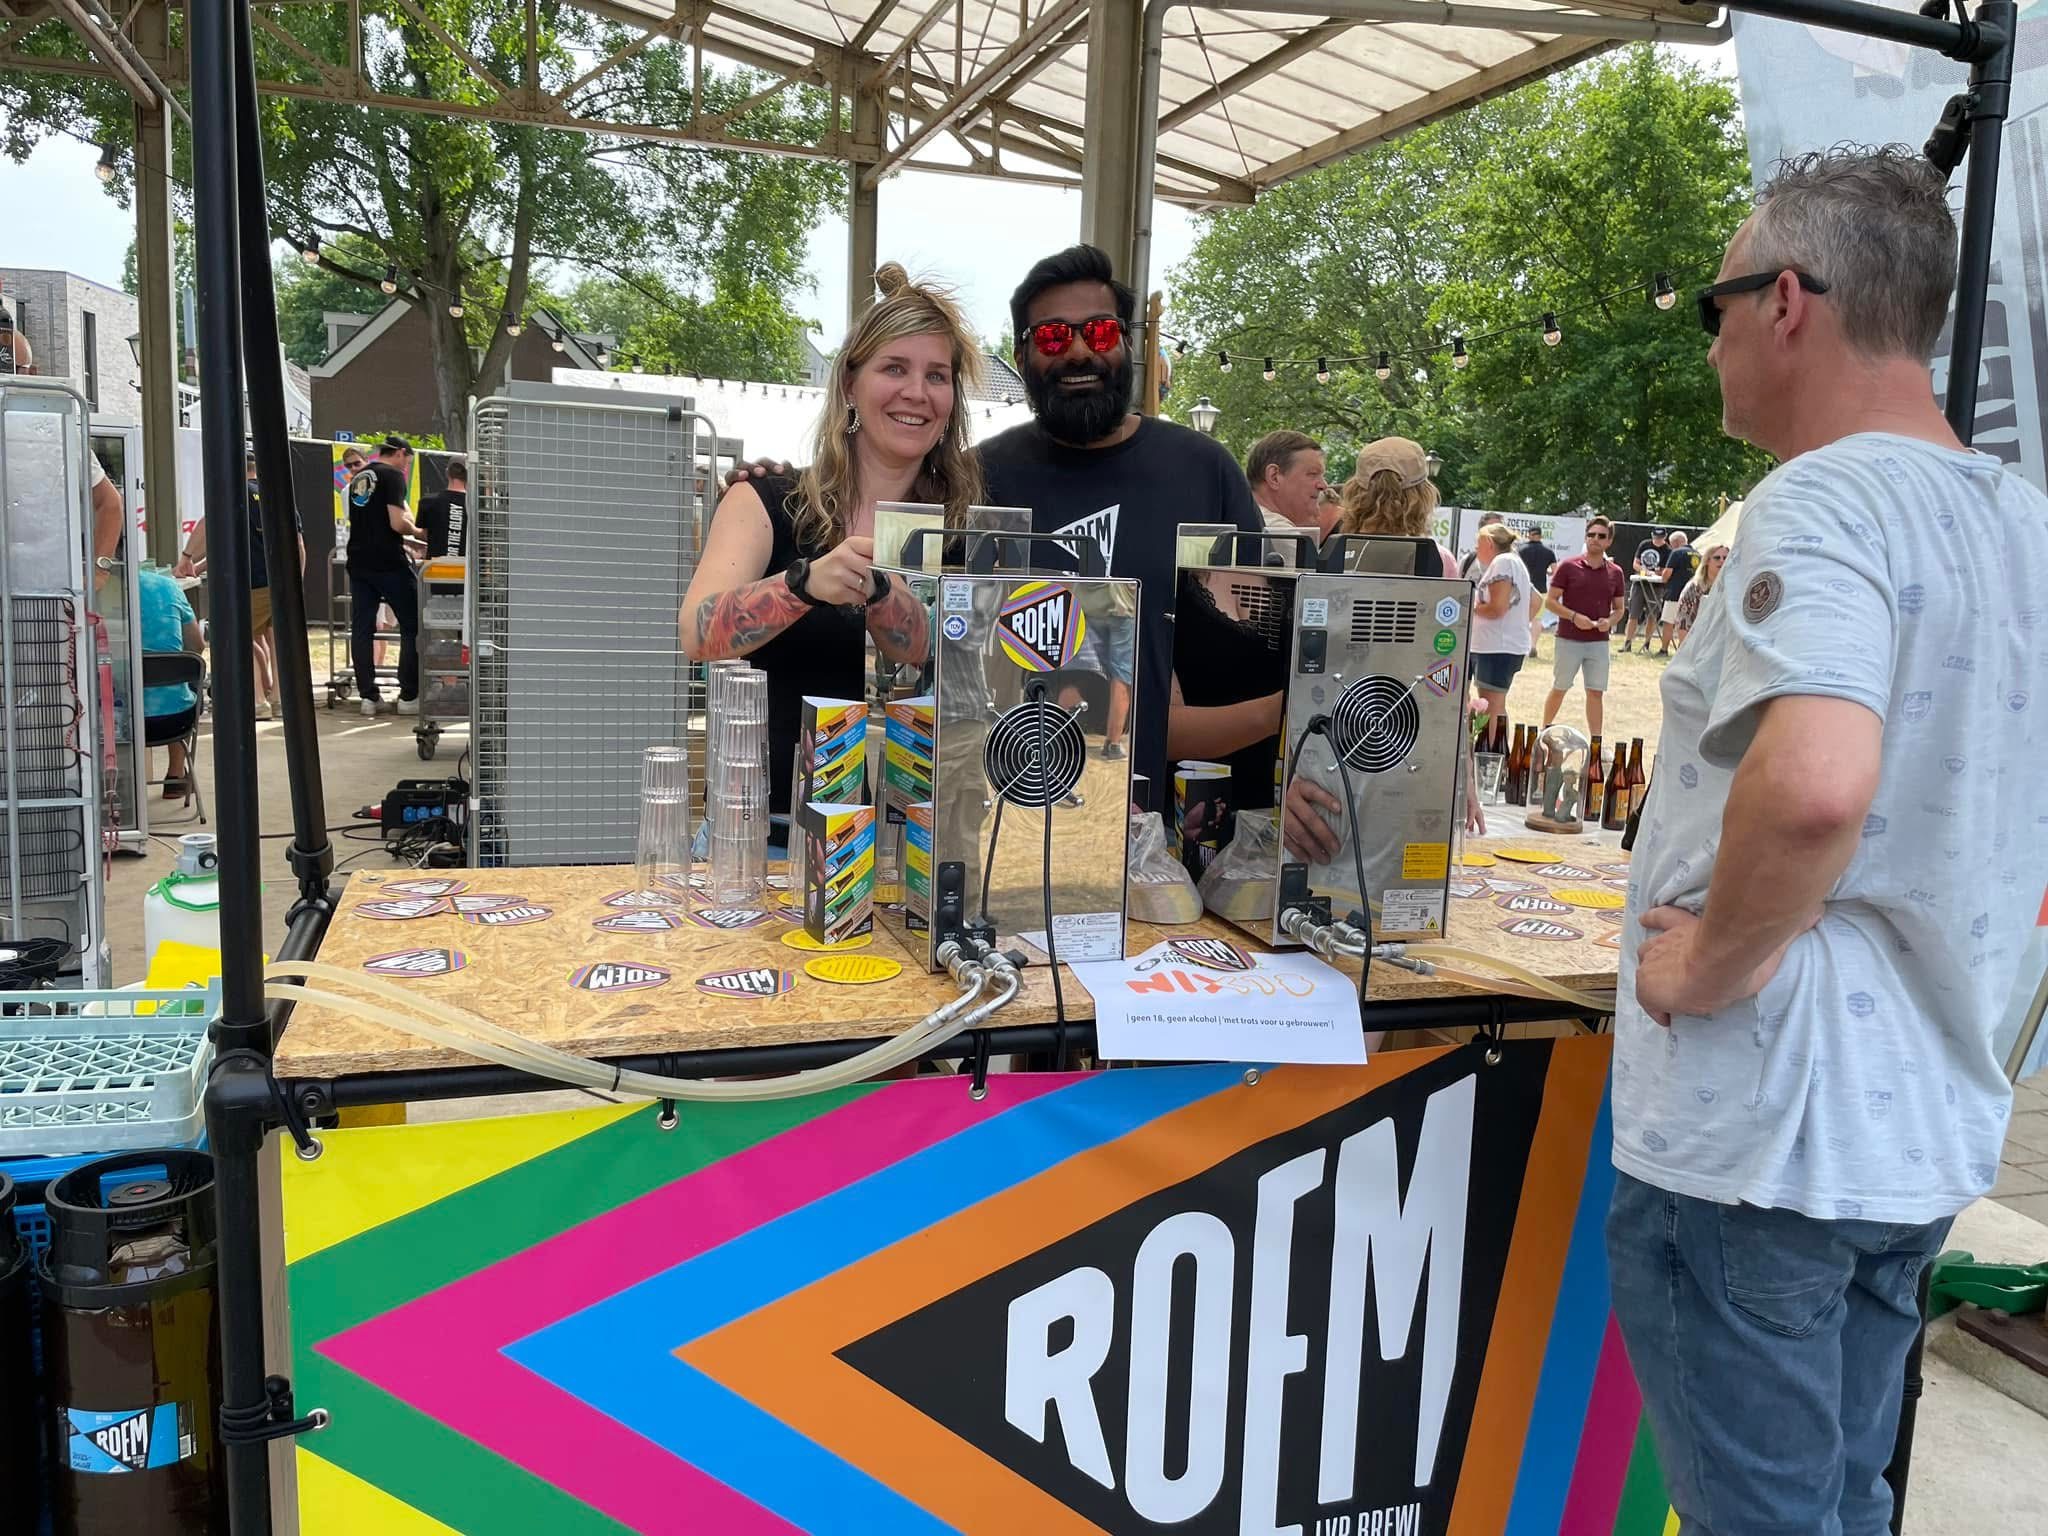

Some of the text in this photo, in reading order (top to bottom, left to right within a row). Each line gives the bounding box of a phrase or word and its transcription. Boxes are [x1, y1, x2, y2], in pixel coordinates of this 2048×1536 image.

[449, 503, 463, 531] GLORY
[448, 529, 461, 548] THE
[1012, 595, 1064, 651] ROEM
[1510, 896, 1566, 910] ROEM
[1510, 920, 1576, 937] ROEM
[1175, 940, 1240, 962] ROEM
[589, 965, 662, 989] ROEM
[704, 968, 775, 993] ROEM
[1130, 1015, 1151, 1023] geen
[1188, 1014, 1217, 1023] alcohol
[1240, 1017, 1258, 1025] trots
[1005, 1073, 1477, 1536] ROEM
[96, 1413, 147, 1462] ROEM
